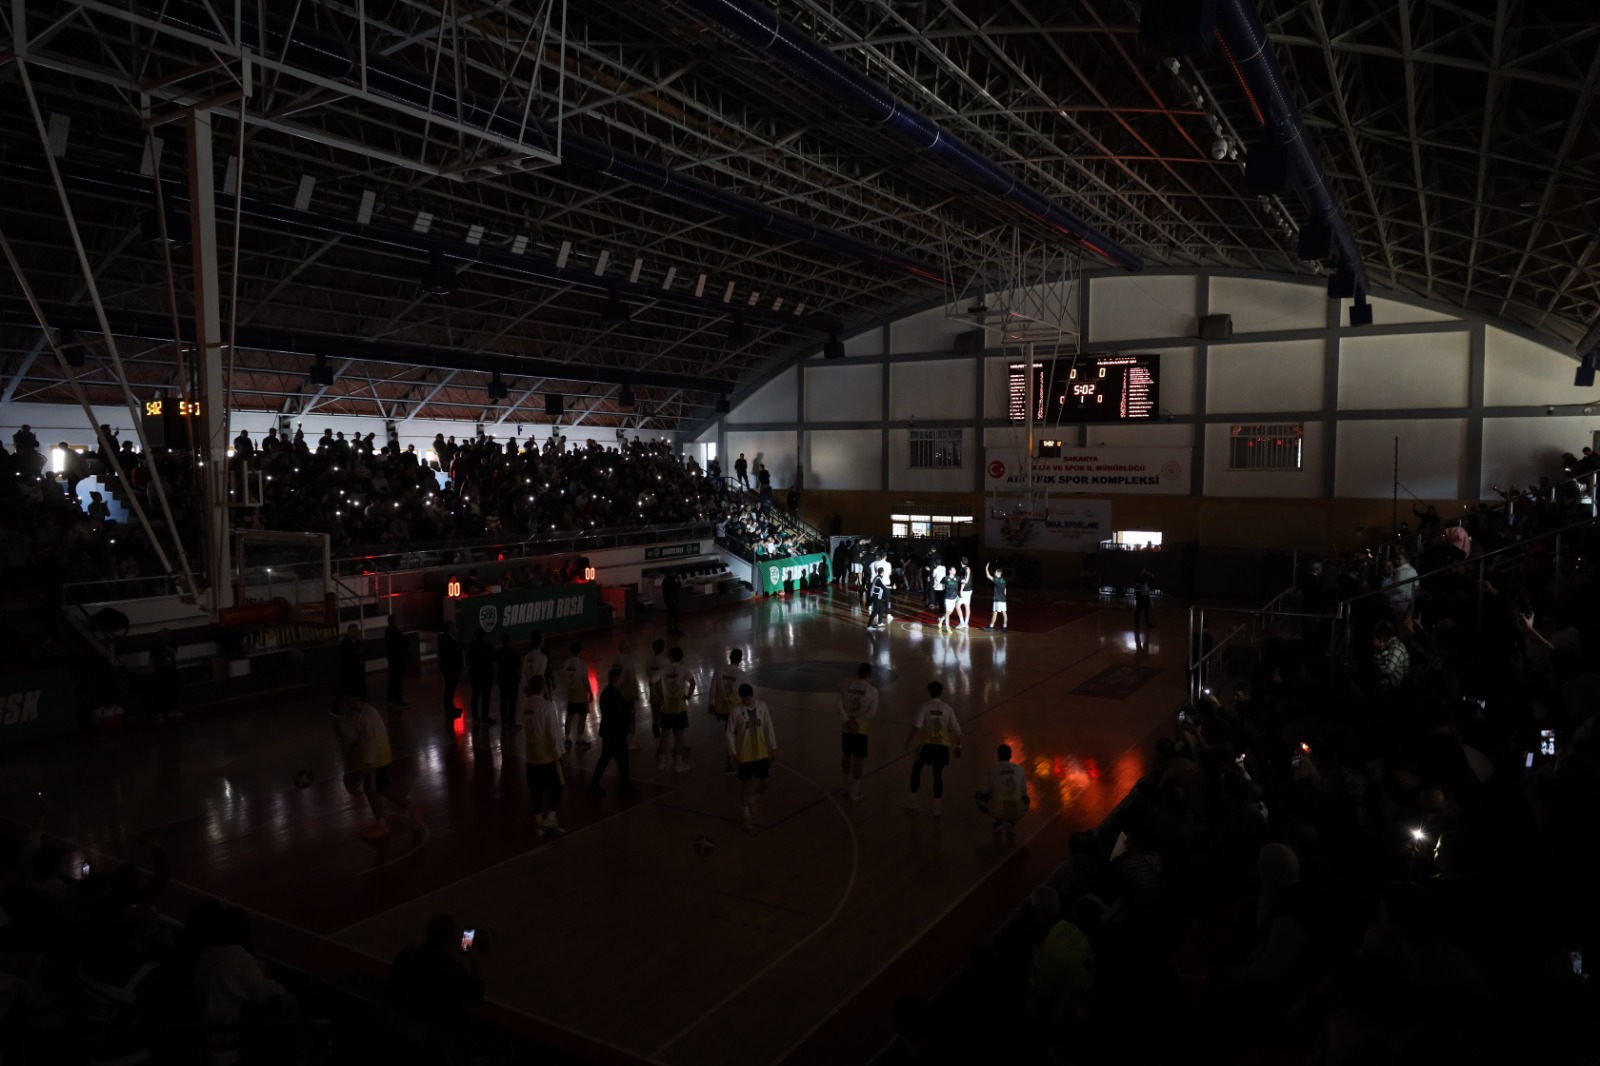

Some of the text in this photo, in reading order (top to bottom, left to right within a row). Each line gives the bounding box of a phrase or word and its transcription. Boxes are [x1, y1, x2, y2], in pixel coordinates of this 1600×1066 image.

[1070, 367, 1106, 379] 0 0
[1074, 384, 1095, 395] 5:02
[1097, 394, 1103, 403] 0
[518, 425, 523, 436] F
[1059, 476, 1088, 484] SPOR
[1092, 475, 1159, 484] KOMPLEKSİ
[585, 567, 595, 580] 00
[448, 582, 461, 597] 00
[502, 595, 585, 627] SAKARYA BBSK
